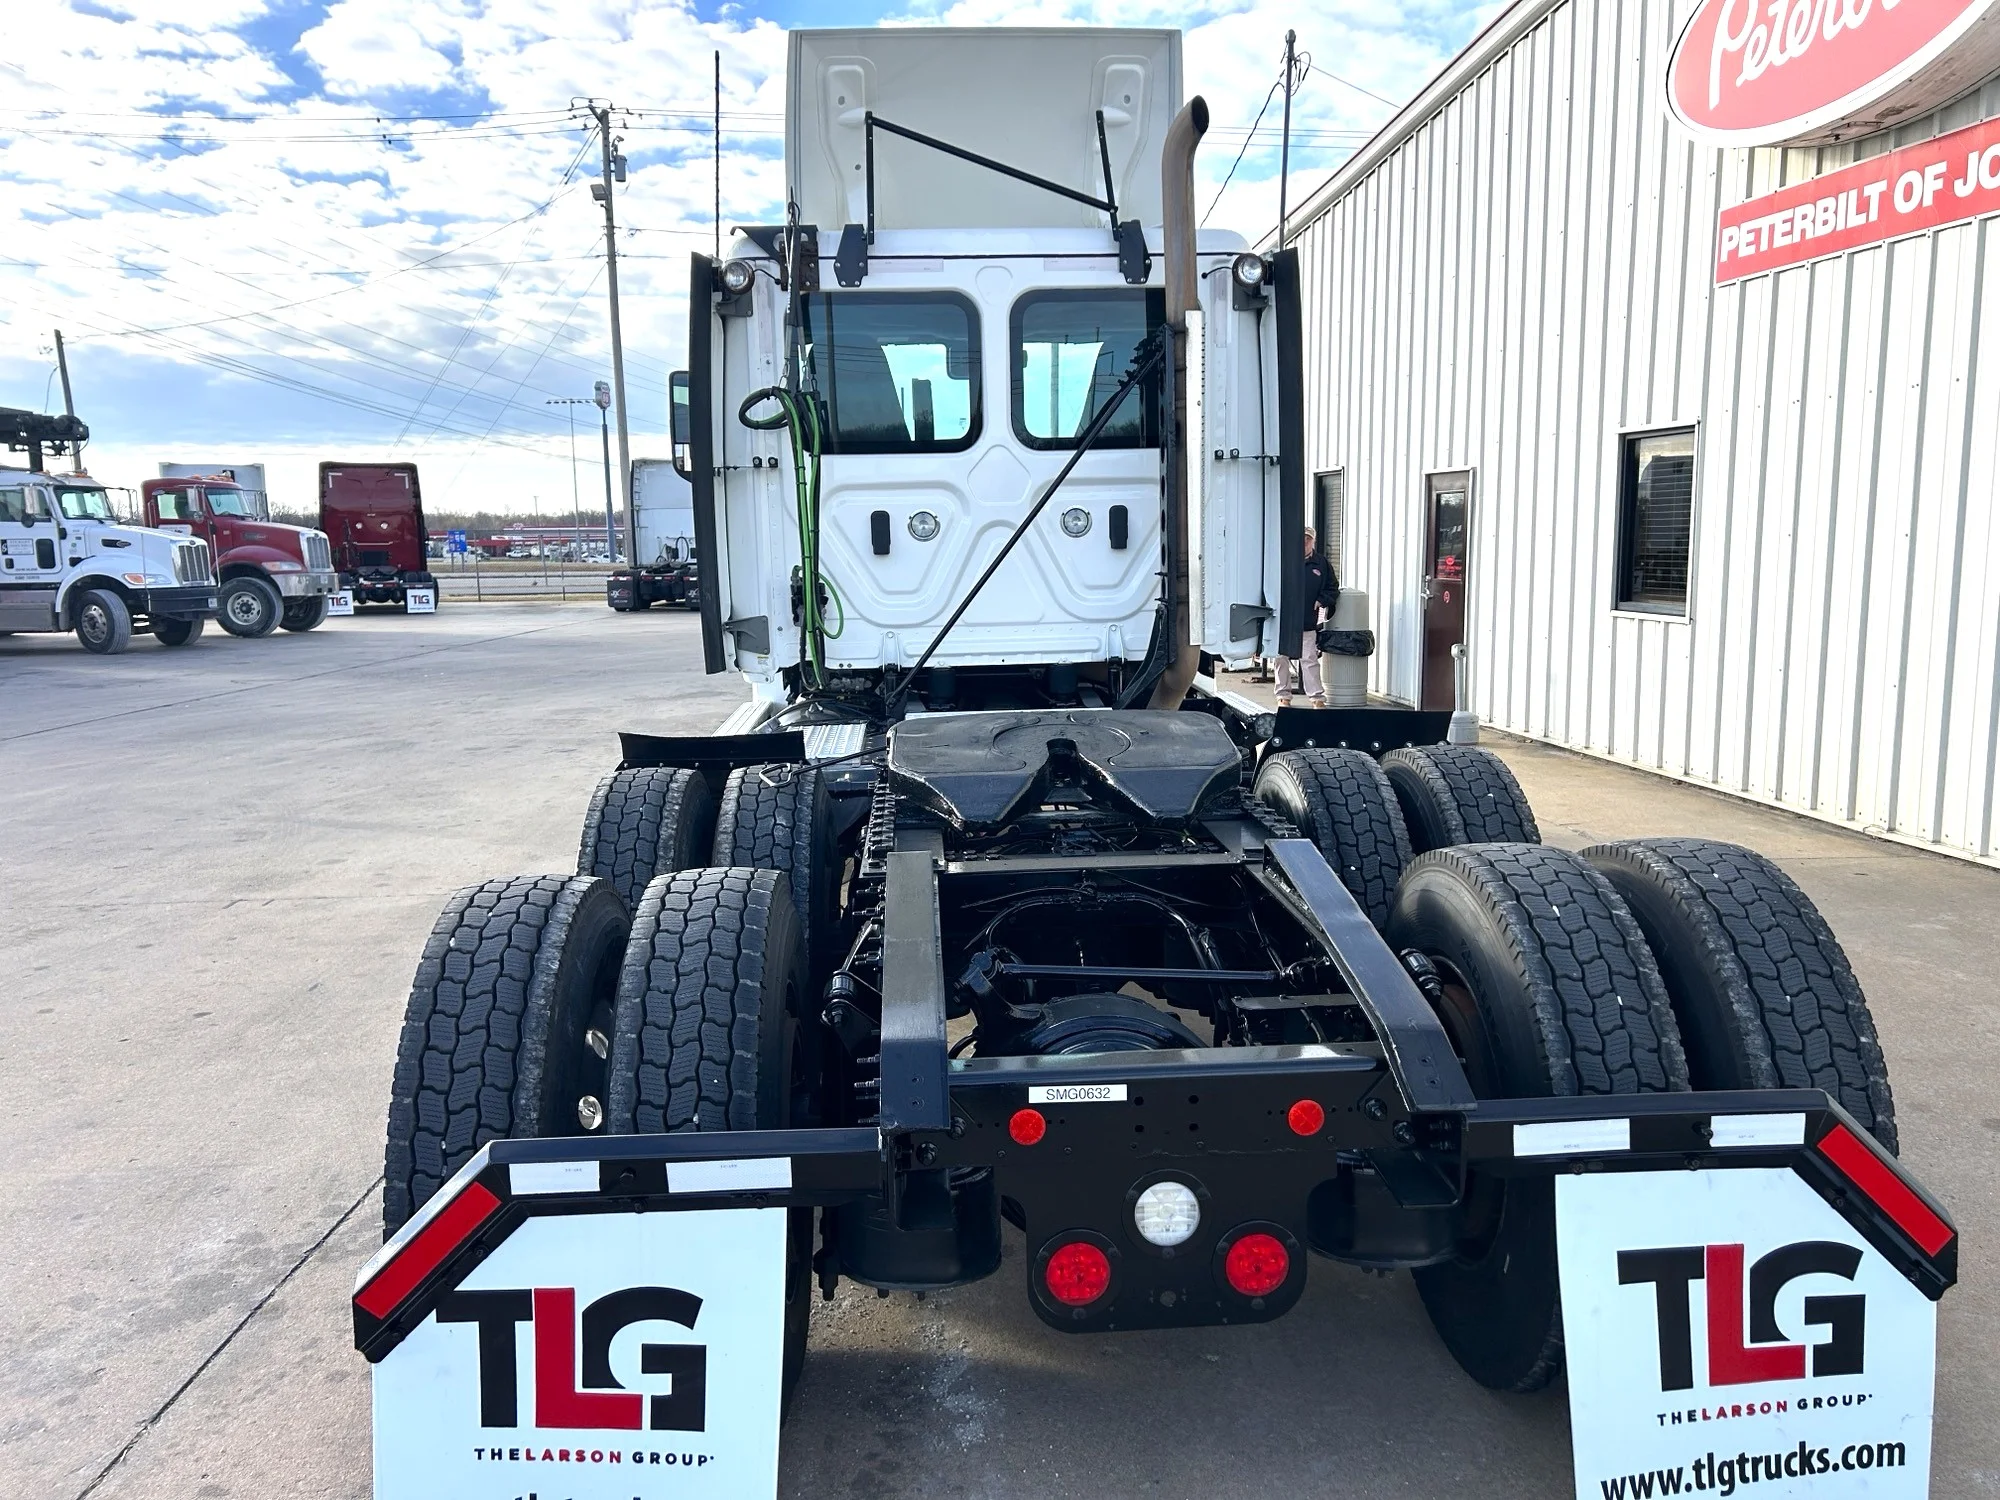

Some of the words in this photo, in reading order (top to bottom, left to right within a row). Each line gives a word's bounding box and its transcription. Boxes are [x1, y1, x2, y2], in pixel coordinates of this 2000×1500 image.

[1720, 179, 1887, 262] PETERBILT
[1894, 161, 1947, 213] OF
[328, 597, 348, 606] TLG
[411, 595, 430, 604] TLG
[1046, 1087, 1111, 1100] SMG0632
[1617, 1241, 1866, 1392] TLG
[435, 1286, 707, 1432] TLG
[1797, 1394, 1867, 1410] GROUP
[632, 1451, 708, 1466] GROUP
[1600, 1440, 1906, 1500] www.tlgtrucks.com
